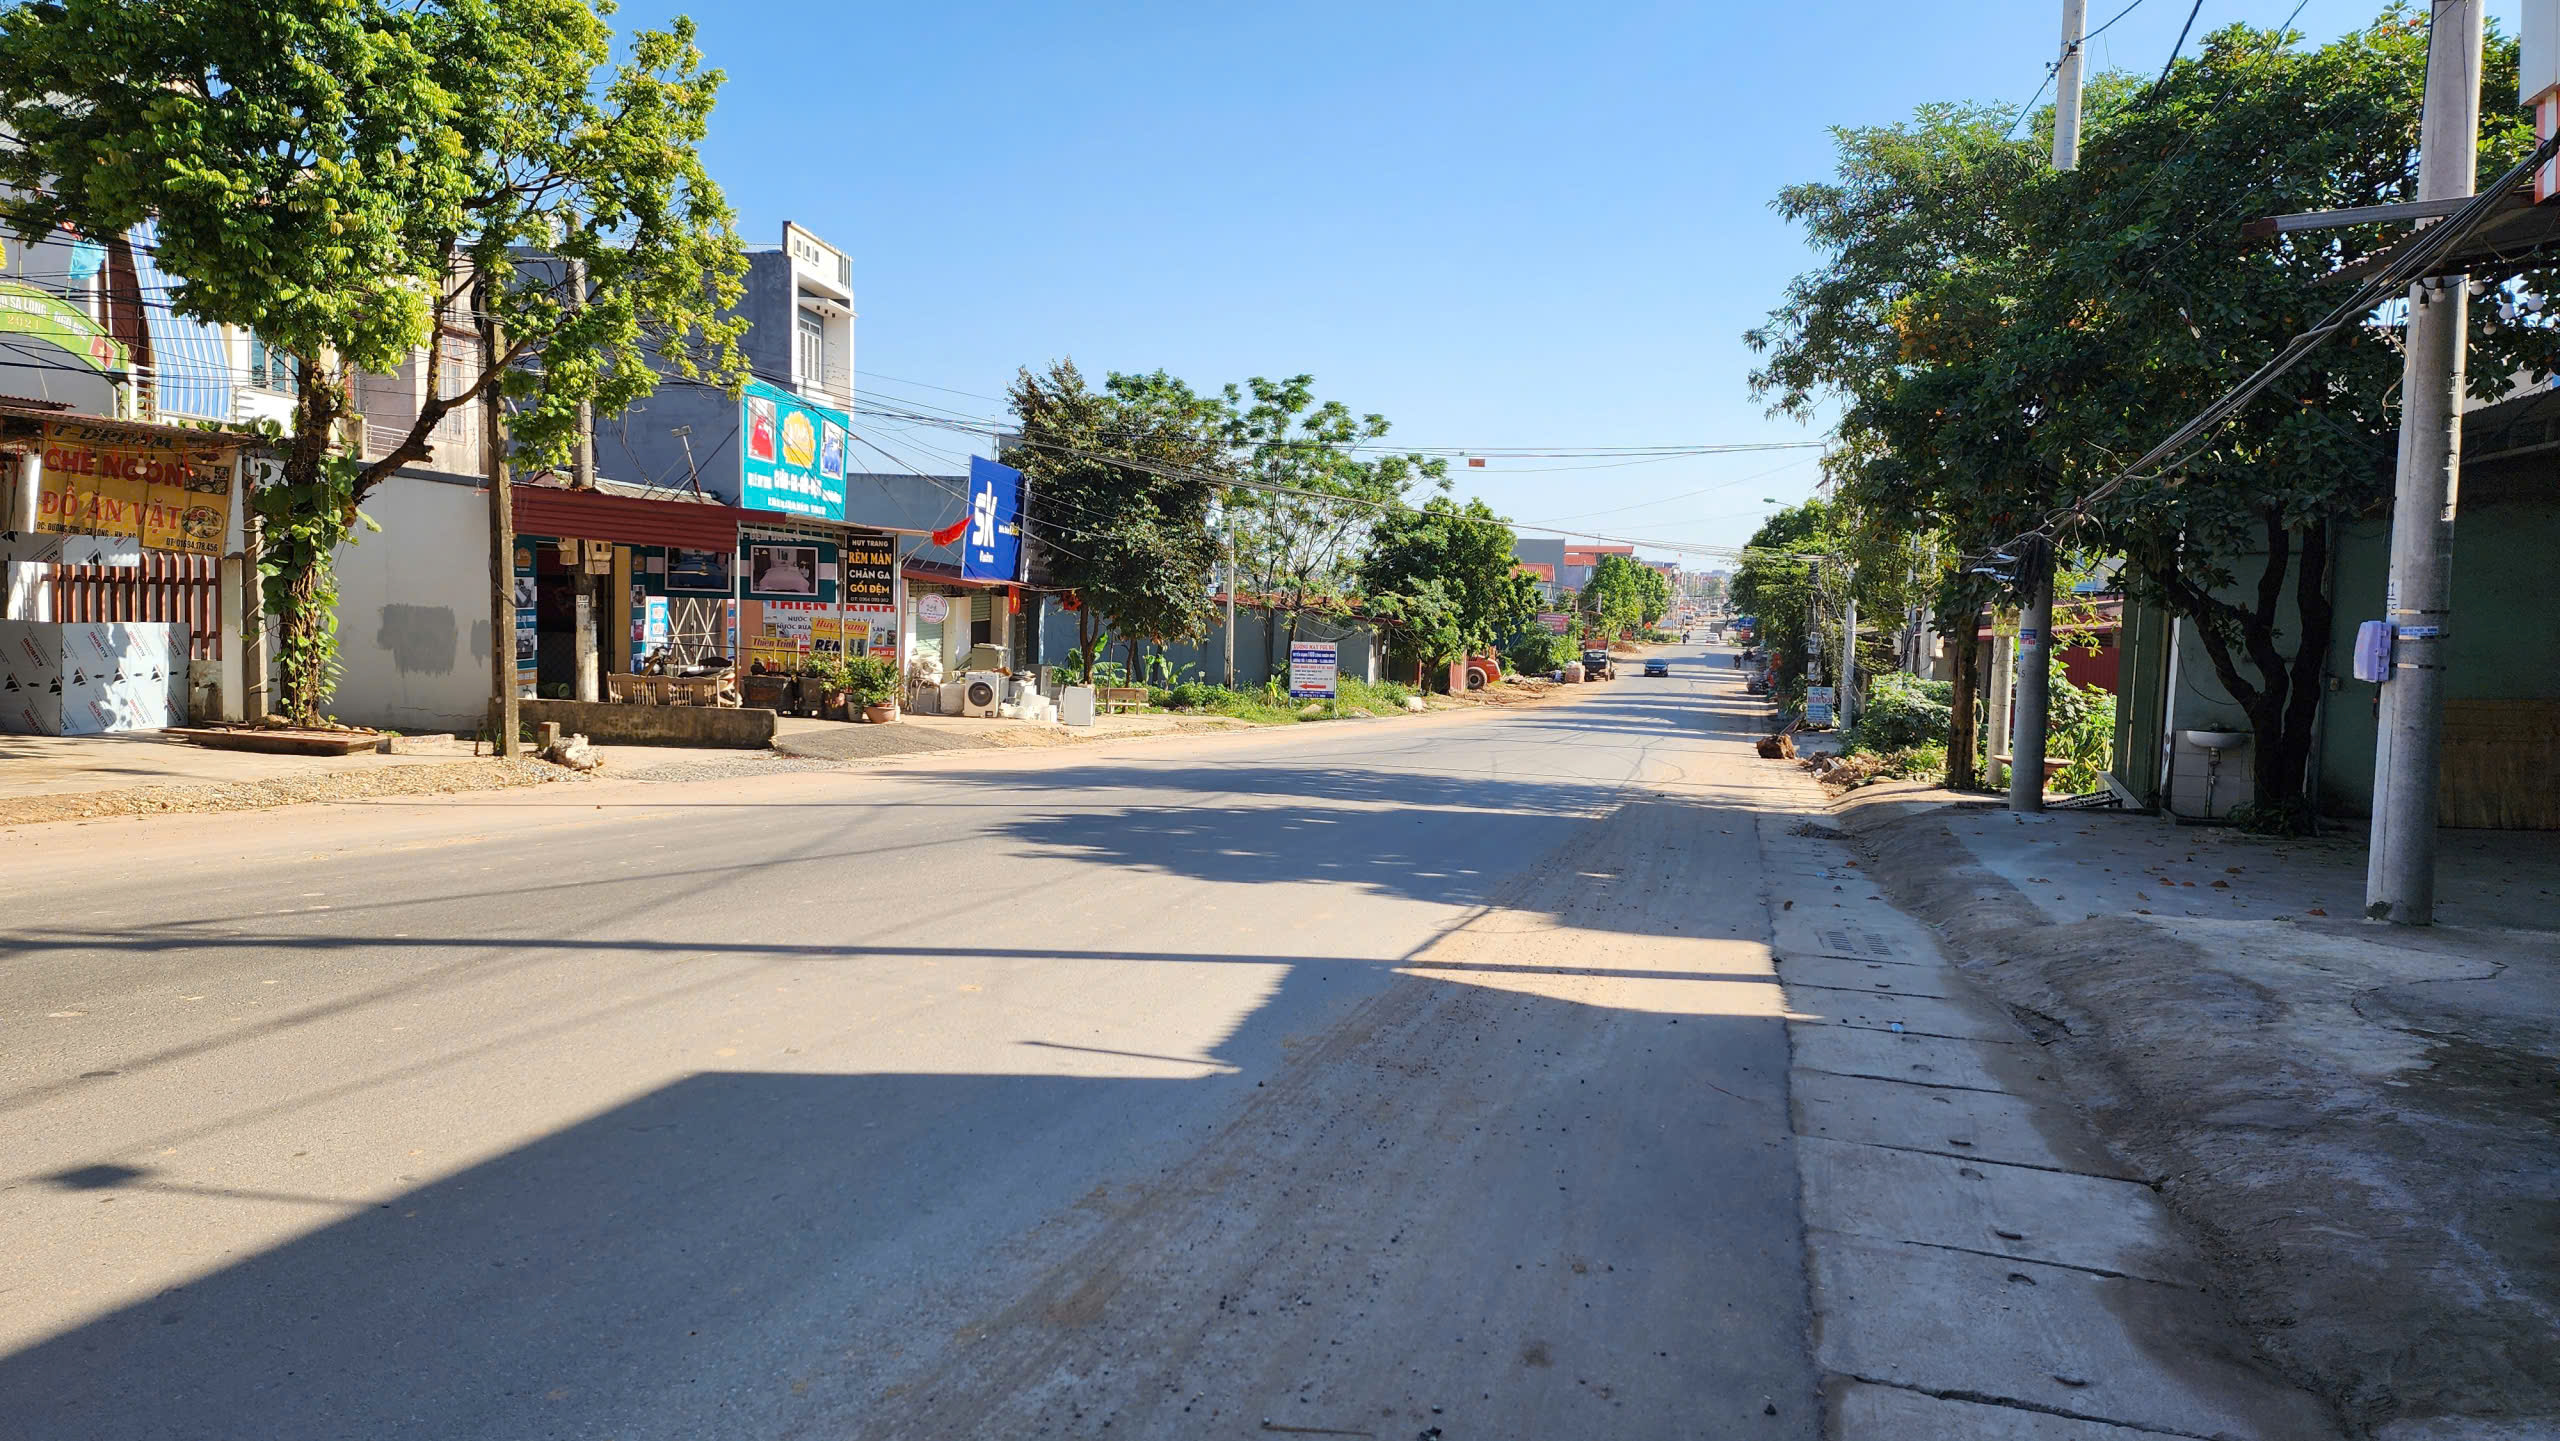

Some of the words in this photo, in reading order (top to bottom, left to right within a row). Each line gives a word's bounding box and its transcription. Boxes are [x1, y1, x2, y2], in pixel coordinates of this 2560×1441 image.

[23, 298, 47, 316] LONG
[7, 315, 41, 330] 2021
[42, 481, 79, 517] ĐỒ
[87, 490, 124, 523] ĂN
[133, 498, 184, 534] VẶT
[852, 539, 865, 547] HUY
[848, 548, 868, 564] RÈM
[870, 549, 892, 565] MÀN
[848, 567, 876, 579] CHĂN
[877, 570, 891, 580] GA
[850, 580, 868, 593] GỐI
[869, 582, 890, 596] ĐỆM
